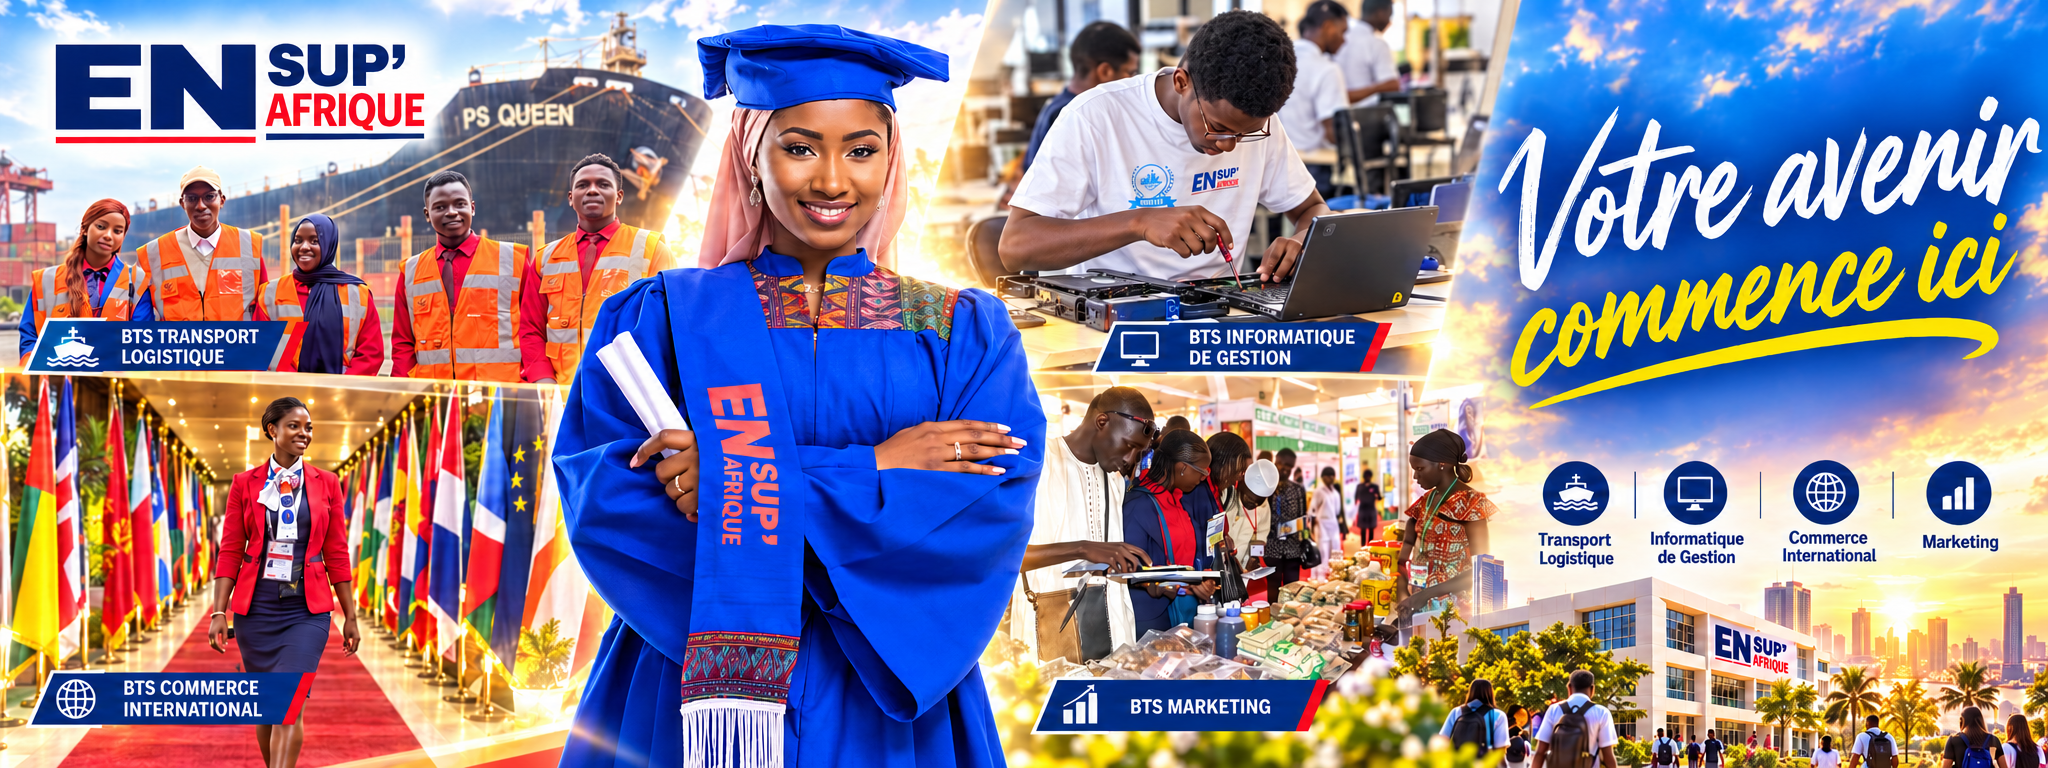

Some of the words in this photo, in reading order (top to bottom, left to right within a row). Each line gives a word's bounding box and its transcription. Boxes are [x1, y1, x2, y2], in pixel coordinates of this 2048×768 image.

[463, 105, 490, 130] PS
[497, 103, 574, 127] QUEEN
[1192, 171, 1217, 192] EN
[706, 383, 776, 460] EN
[721, 456, 744, 546] AFRIQUE
[1715, 624, 1751, 664] EN
[1753, 654, 1789, 674] AFRIQUE
